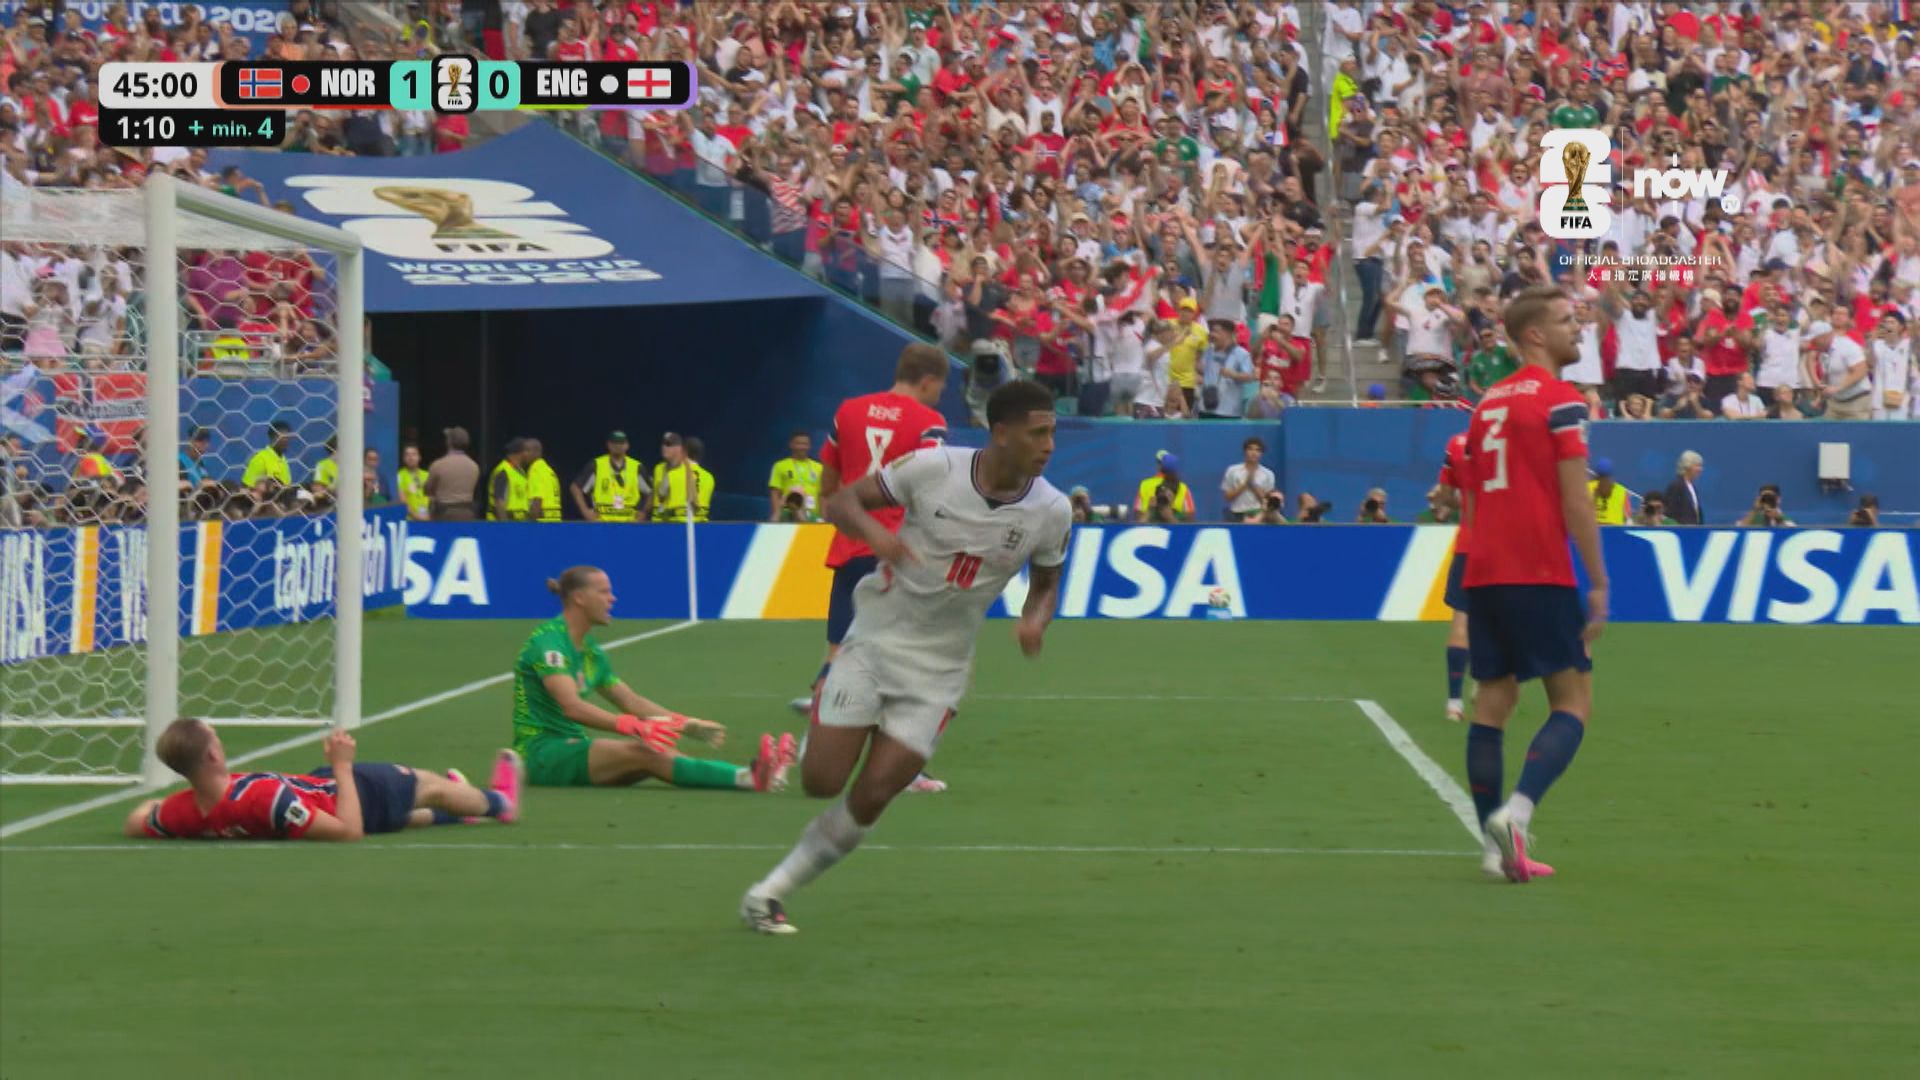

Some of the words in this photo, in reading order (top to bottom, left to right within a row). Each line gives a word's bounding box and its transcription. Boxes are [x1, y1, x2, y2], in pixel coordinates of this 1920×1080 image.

[387, 261, 549, 273] WORLD
[556, 259, 642, 271] CUP
[402, 268, 663, 285] 2026
[1481, 406, 1509, 492] 3
[946, 551, 984, 590] 10
[1624, 530, 1920, 623] VISA
